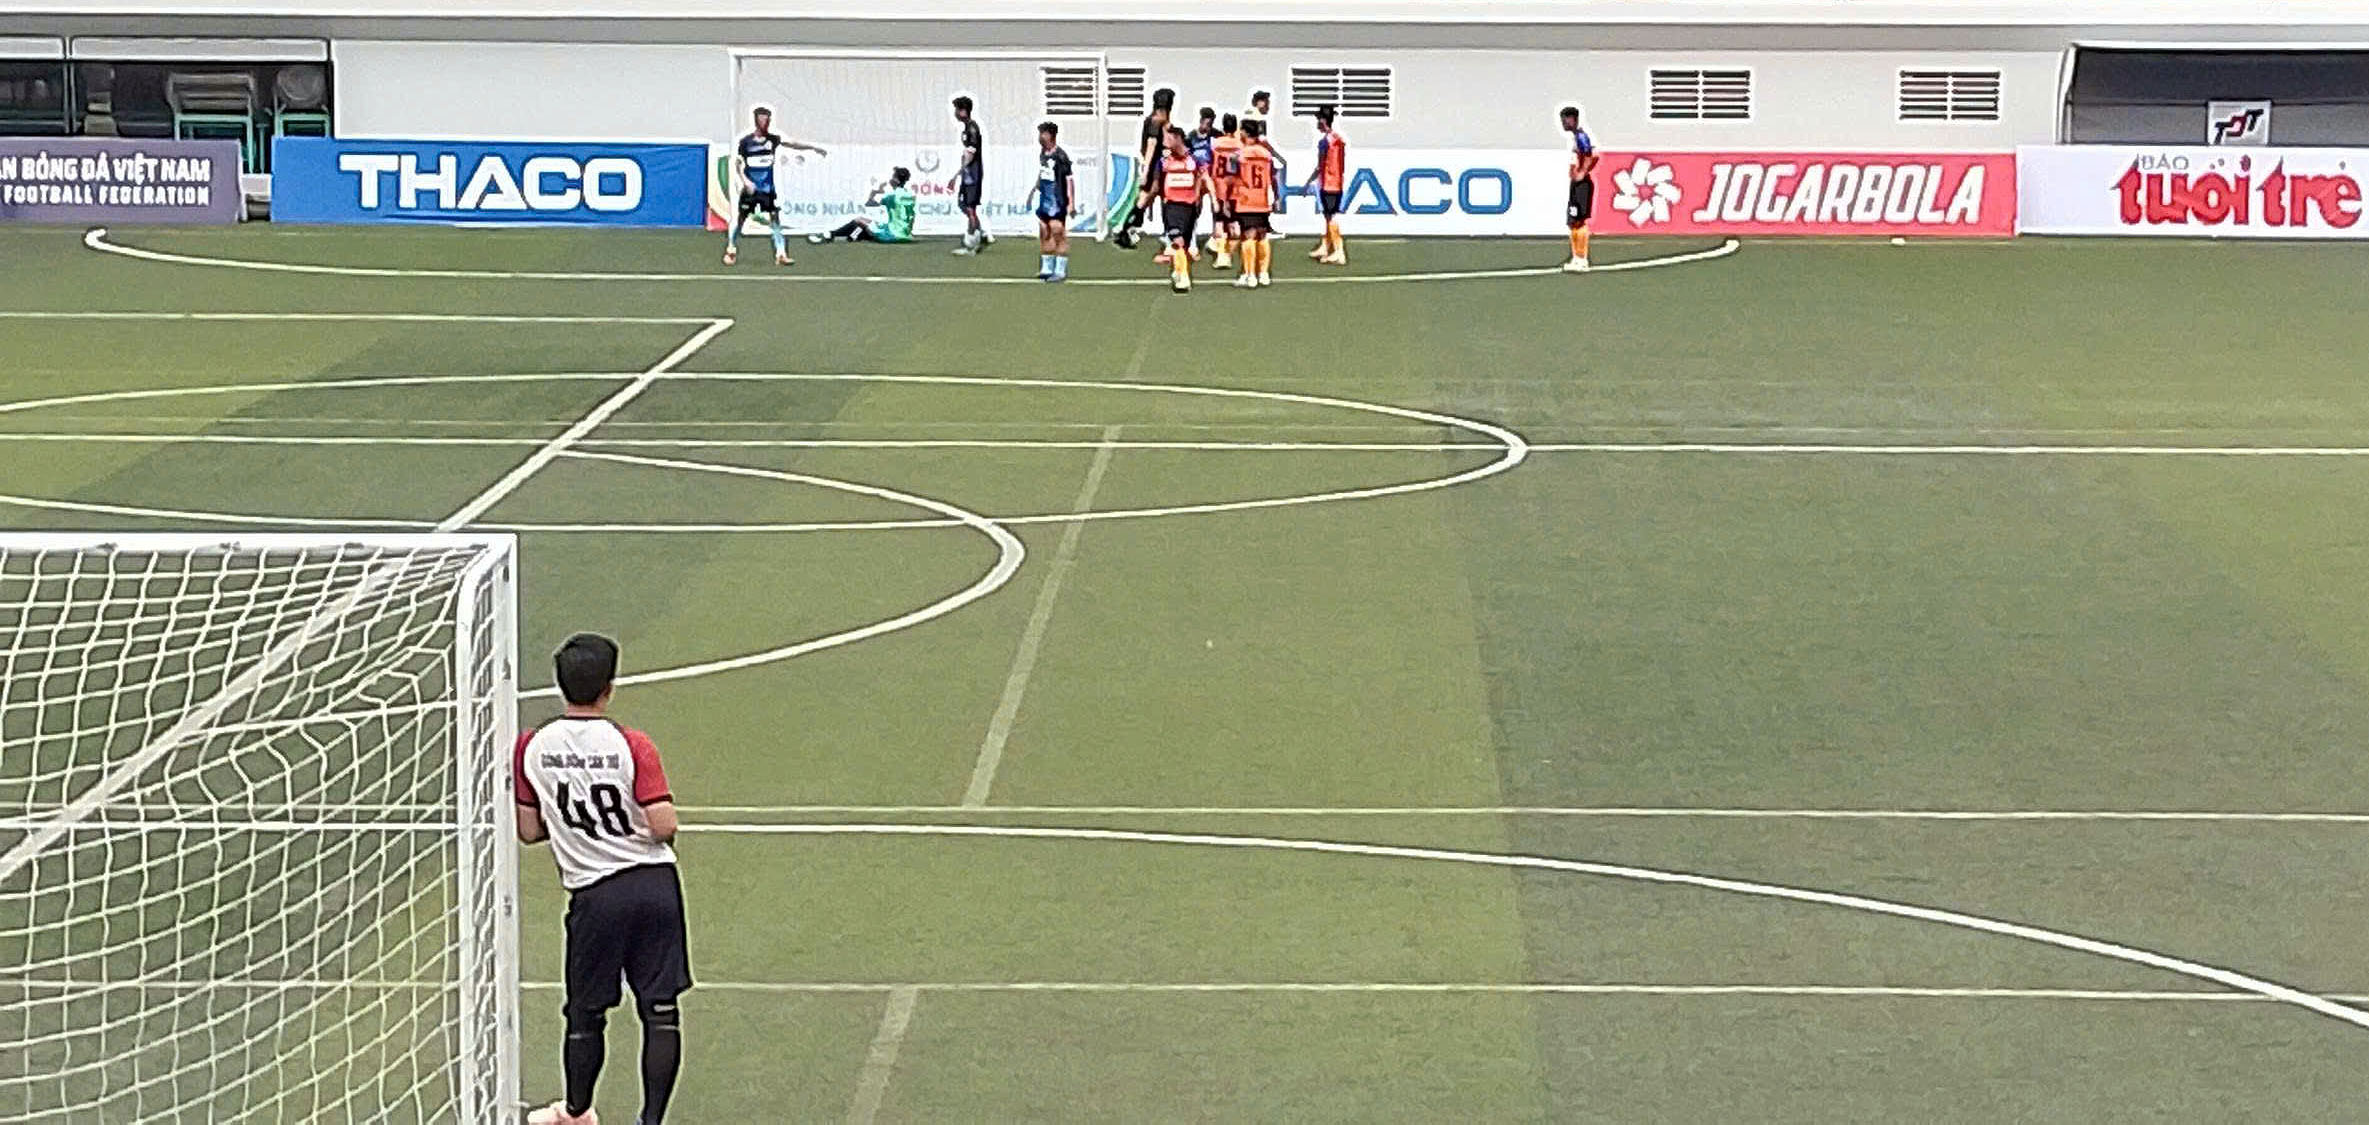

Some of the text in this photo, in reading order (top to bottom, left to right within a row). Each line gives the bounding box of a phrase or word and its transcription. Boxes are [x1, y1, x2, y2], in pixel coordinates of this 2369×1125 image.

[3, 184, 209, 205] FOOTBALL FEDERATION
[160, 158, 210, 182] NAM
[339, 154, 643, 211] THACO
[1274, 168, 1512, 215] HACO
[1692, 163, 1987, 225] JOGARBOLA
[556, 780, 636, 841] 48
